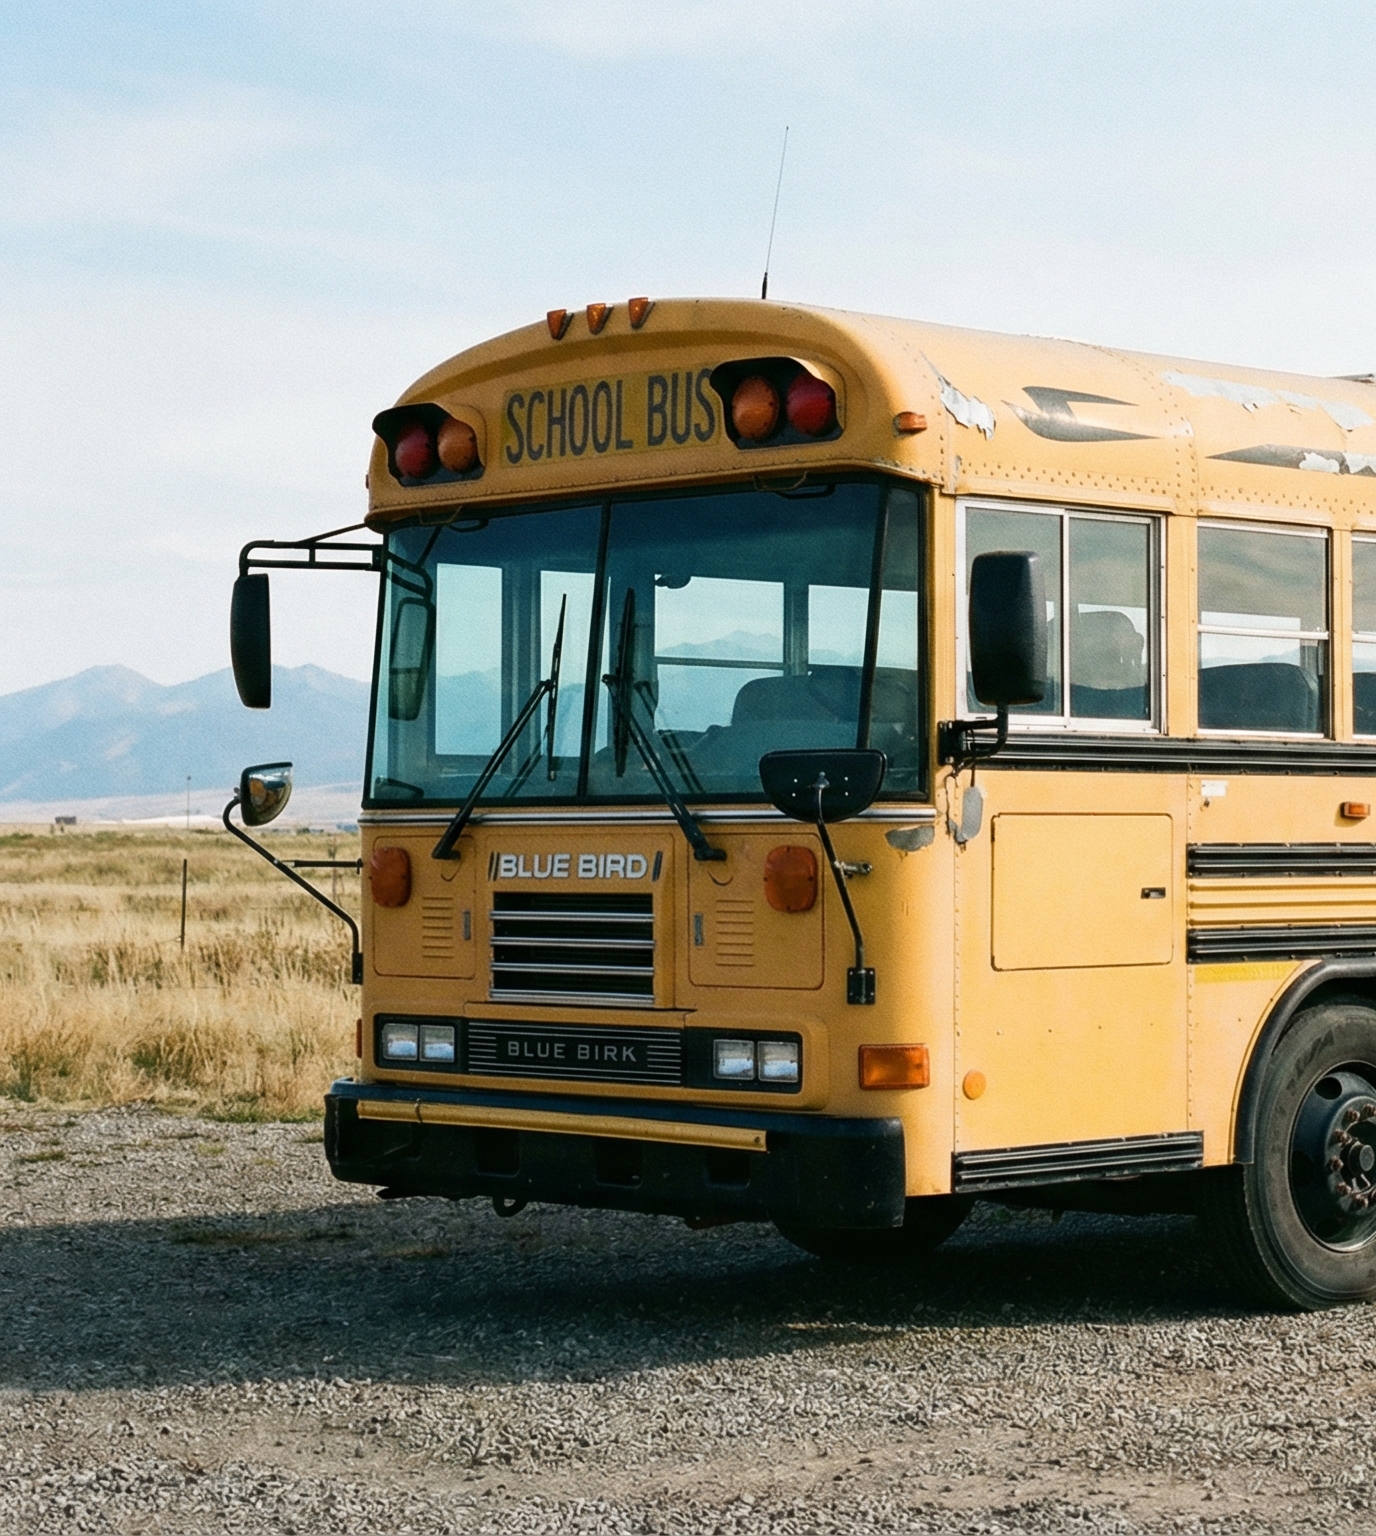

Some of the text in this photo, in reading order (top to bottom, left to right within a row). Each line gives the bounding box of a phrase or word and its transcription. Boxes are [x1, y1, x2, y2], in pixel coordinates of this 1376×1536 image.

[506, 367, 716, 465] SCHOOL BUS
[499, 853, 648, 879] BLUE BIRD
[507, 1040, 637, 1063] BLUE BIRK
